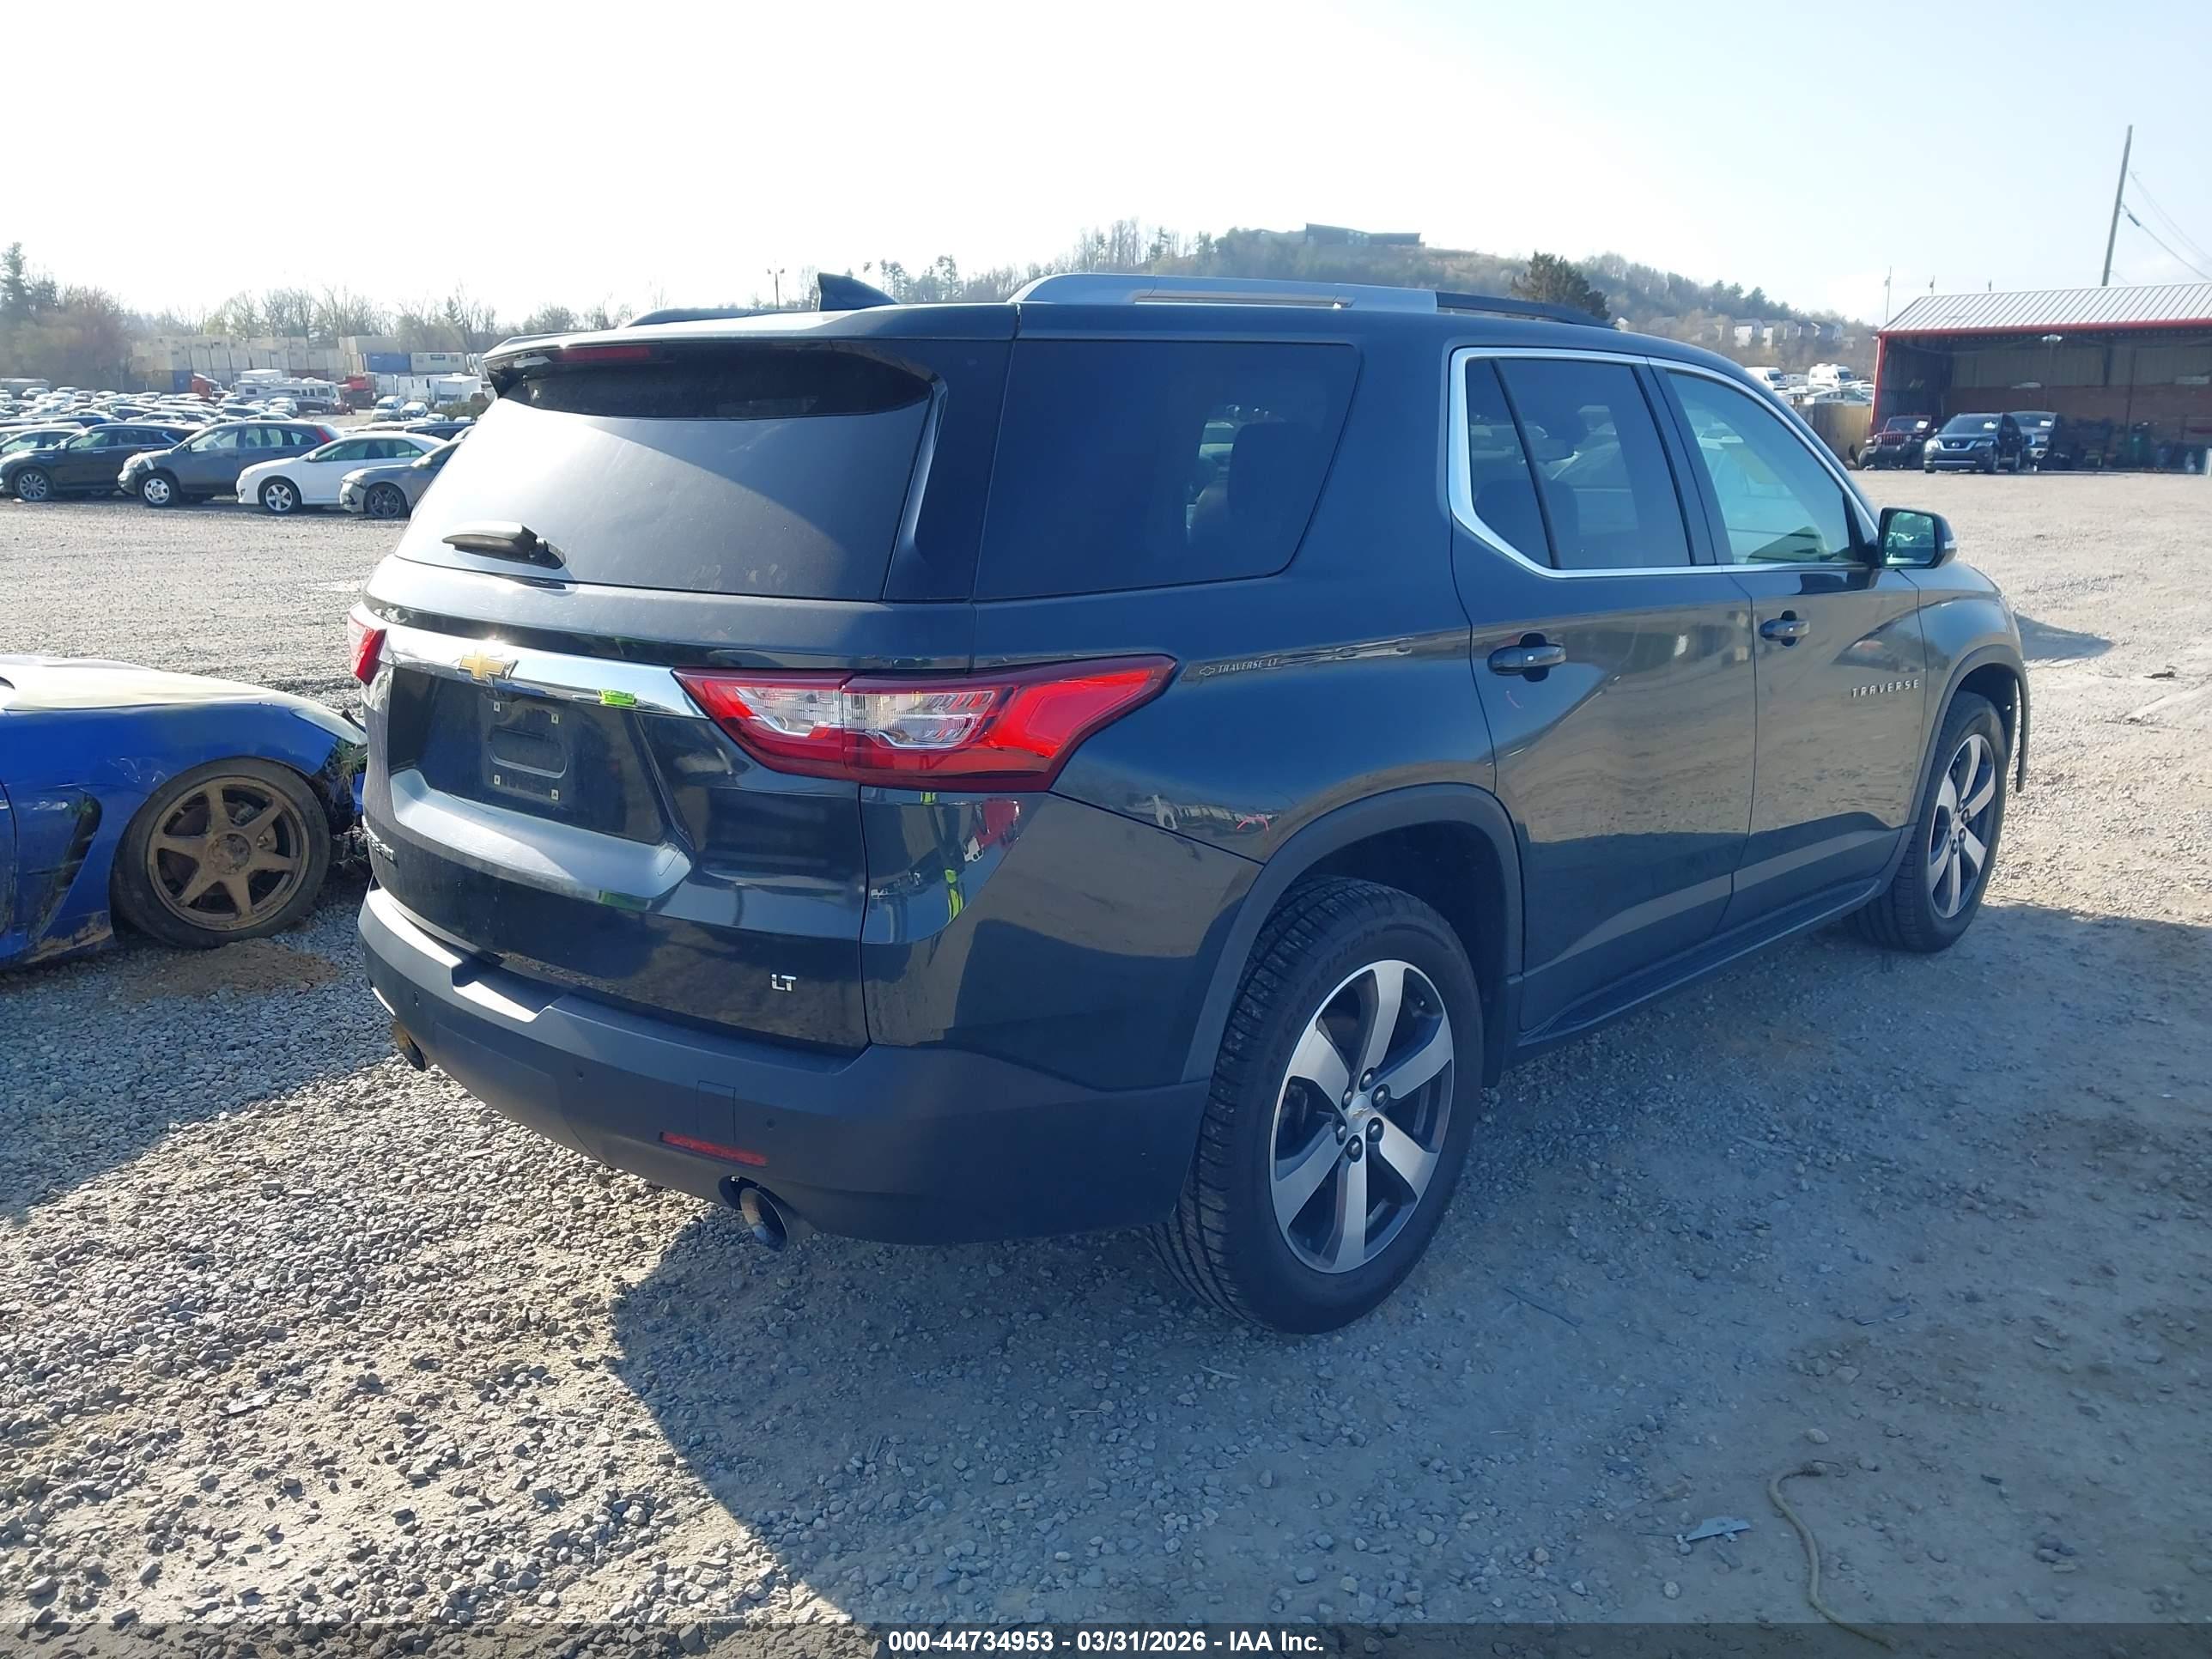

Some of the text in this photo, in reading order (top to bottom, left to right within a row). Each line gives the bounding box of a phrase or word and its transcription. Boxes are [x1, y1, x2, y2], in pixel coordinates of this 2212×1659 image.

[1218, 658, 1279, 674] TRAVERSE LT
[1852, 679, 1919, 698] TRAVERSE
[771, 974, 797, 992] LT
